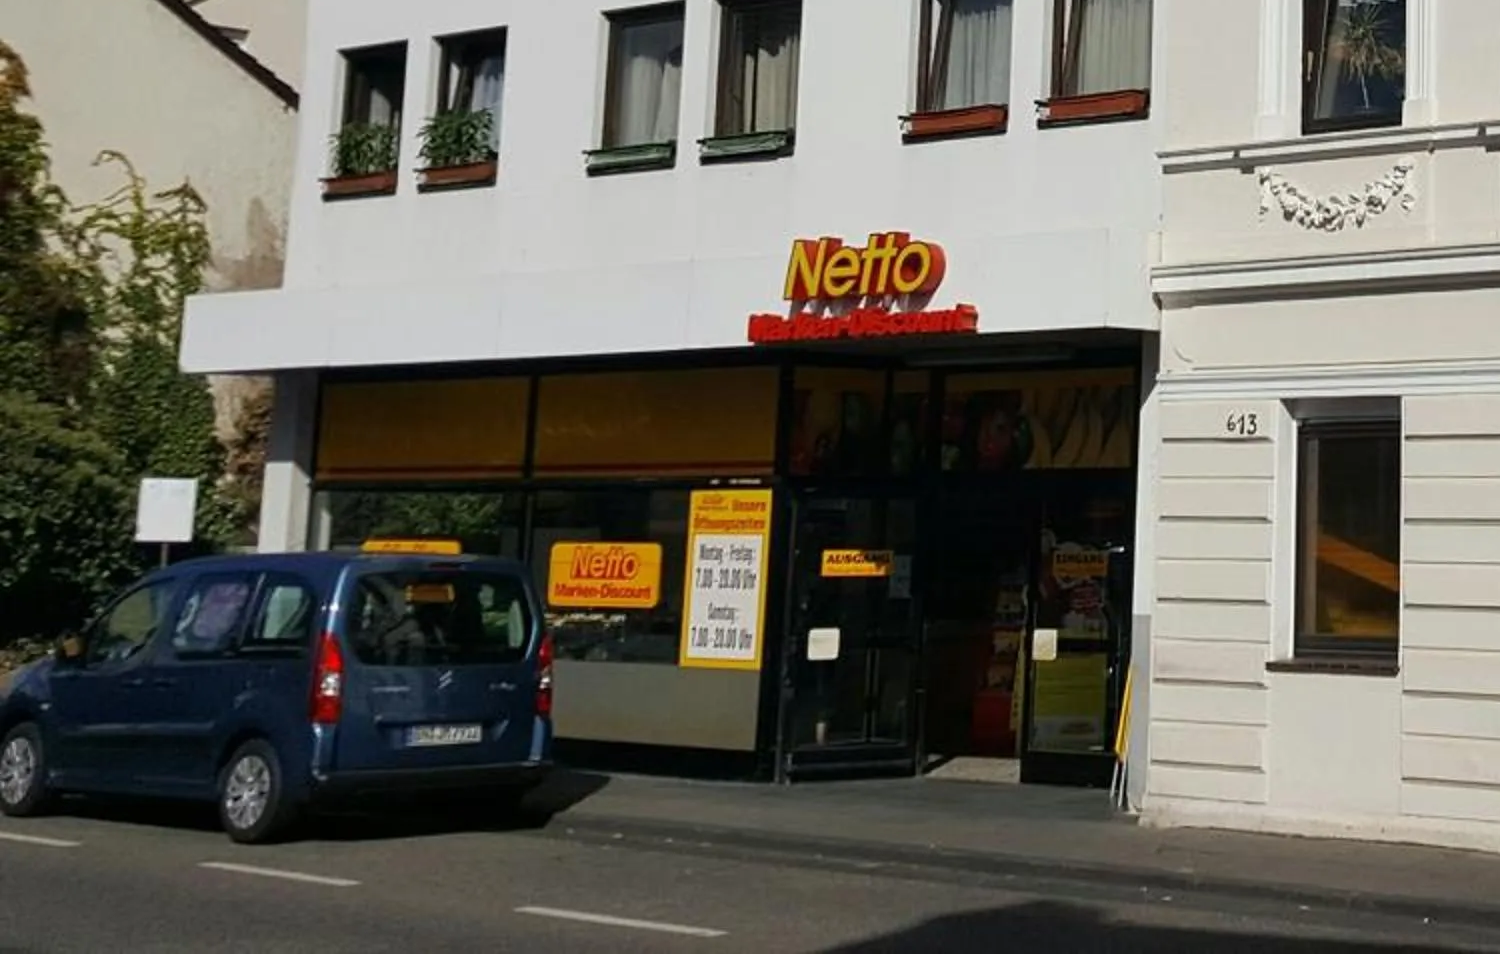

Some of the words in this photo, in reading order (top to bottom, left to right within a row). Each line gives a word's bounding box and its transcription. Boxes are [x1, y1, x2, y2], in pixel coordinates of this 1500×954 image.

[783, 231, 946, 300] Netto
[1226, 413, 1257, 435] 613
[572, 546, 640, 579] Netto
[554, 583, 654, 599] Marken-Discount
